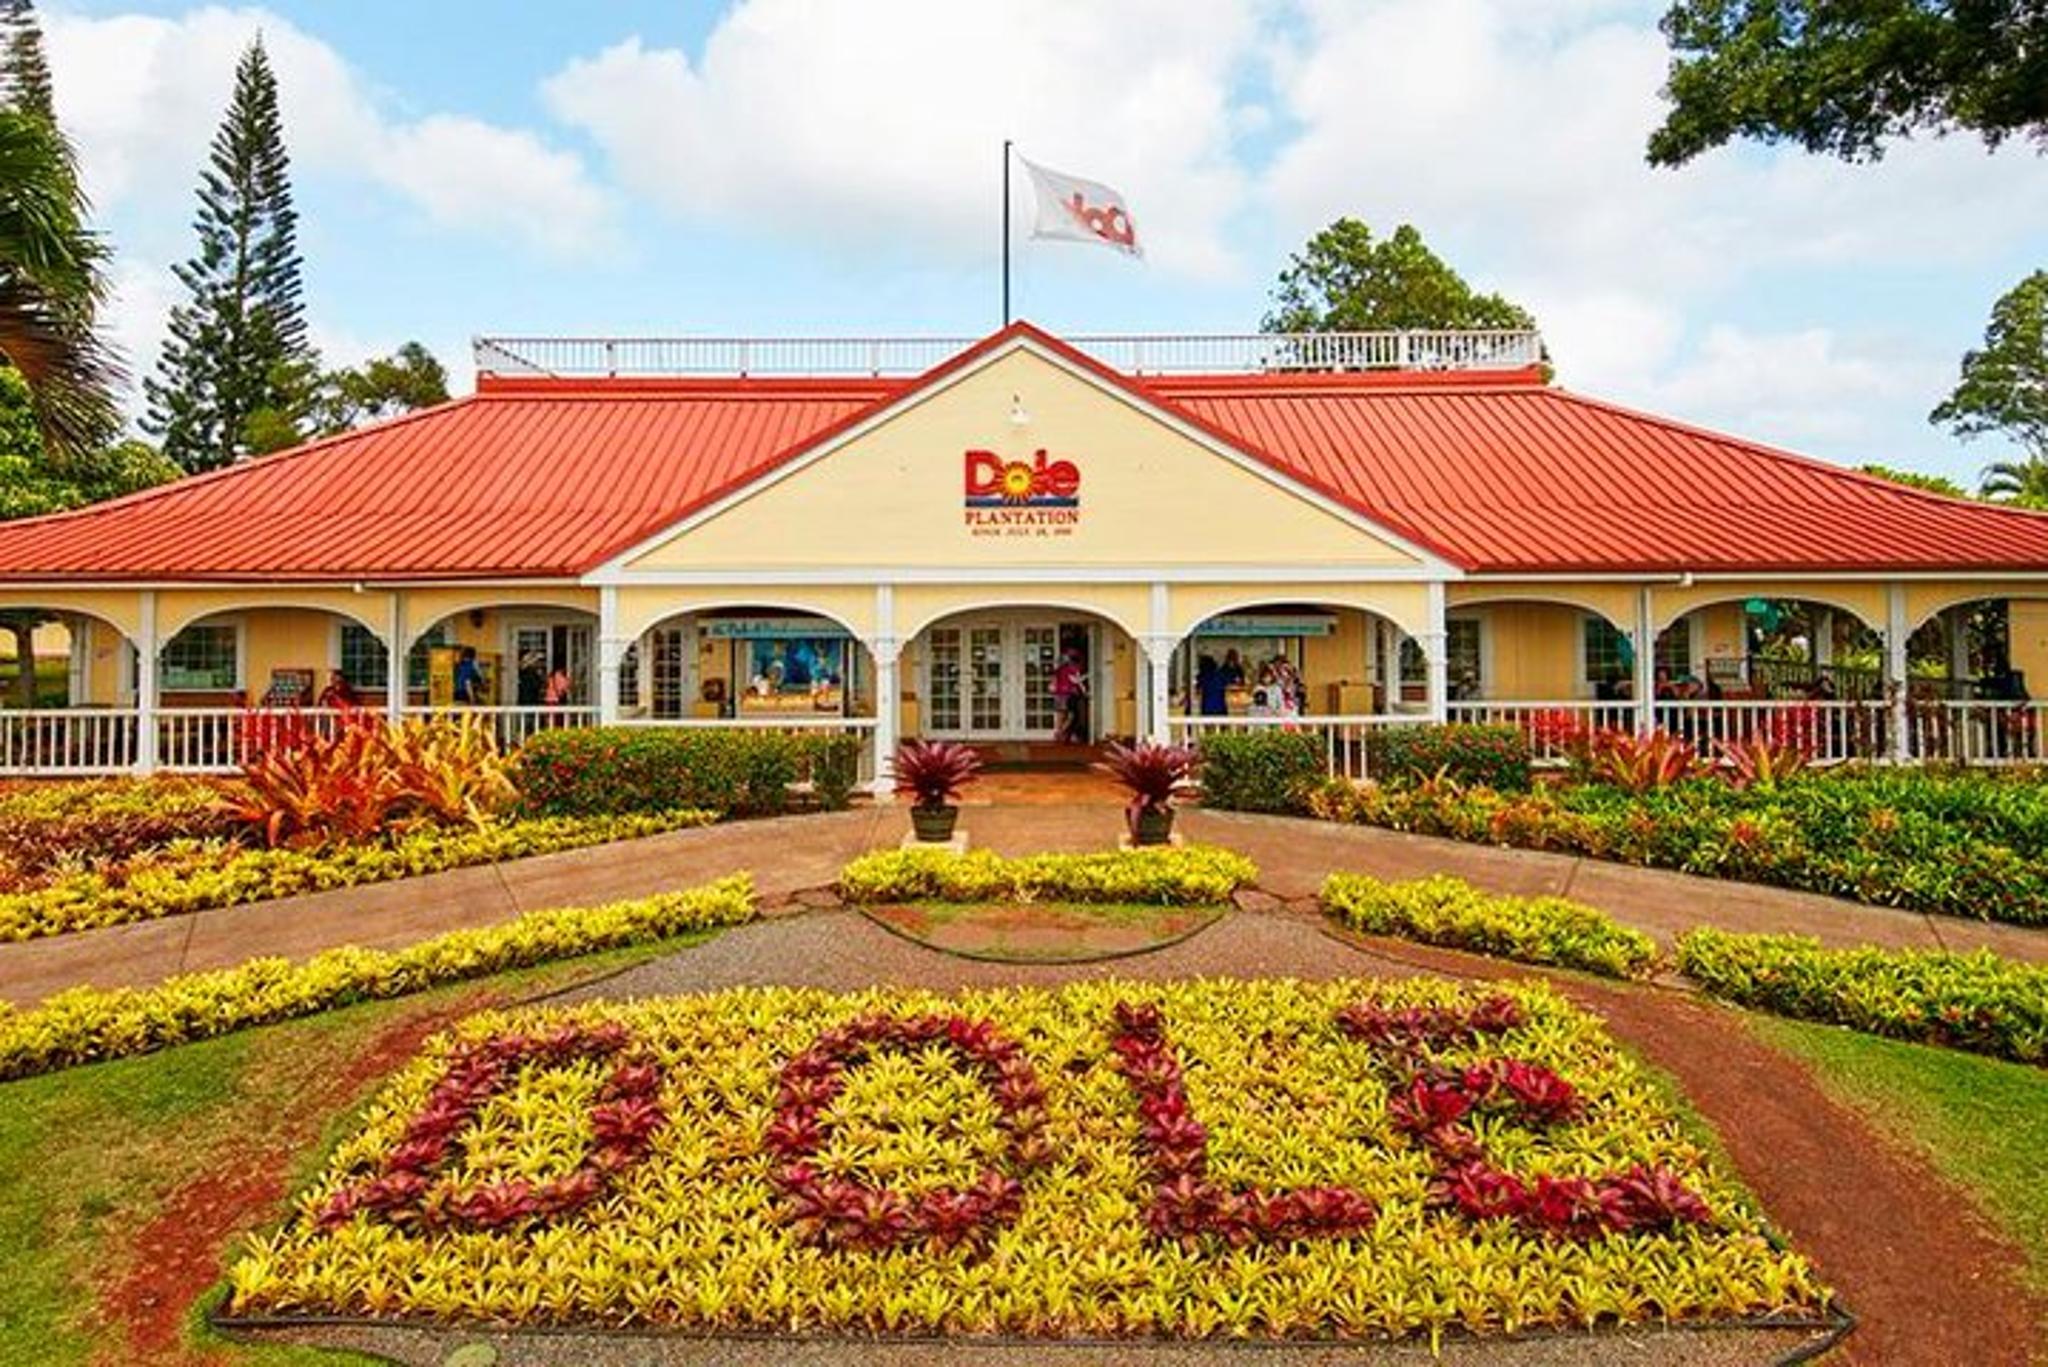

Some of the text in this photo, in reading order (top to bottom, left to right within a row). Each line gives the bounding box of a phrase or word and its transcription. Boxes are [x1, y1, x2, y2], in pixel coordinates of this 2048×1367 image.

[965, 449, 1080, 499] Dole
[965, 511, 1078, 525] PLANTATION
[317, 1000, 1712, 1248] DOLE
